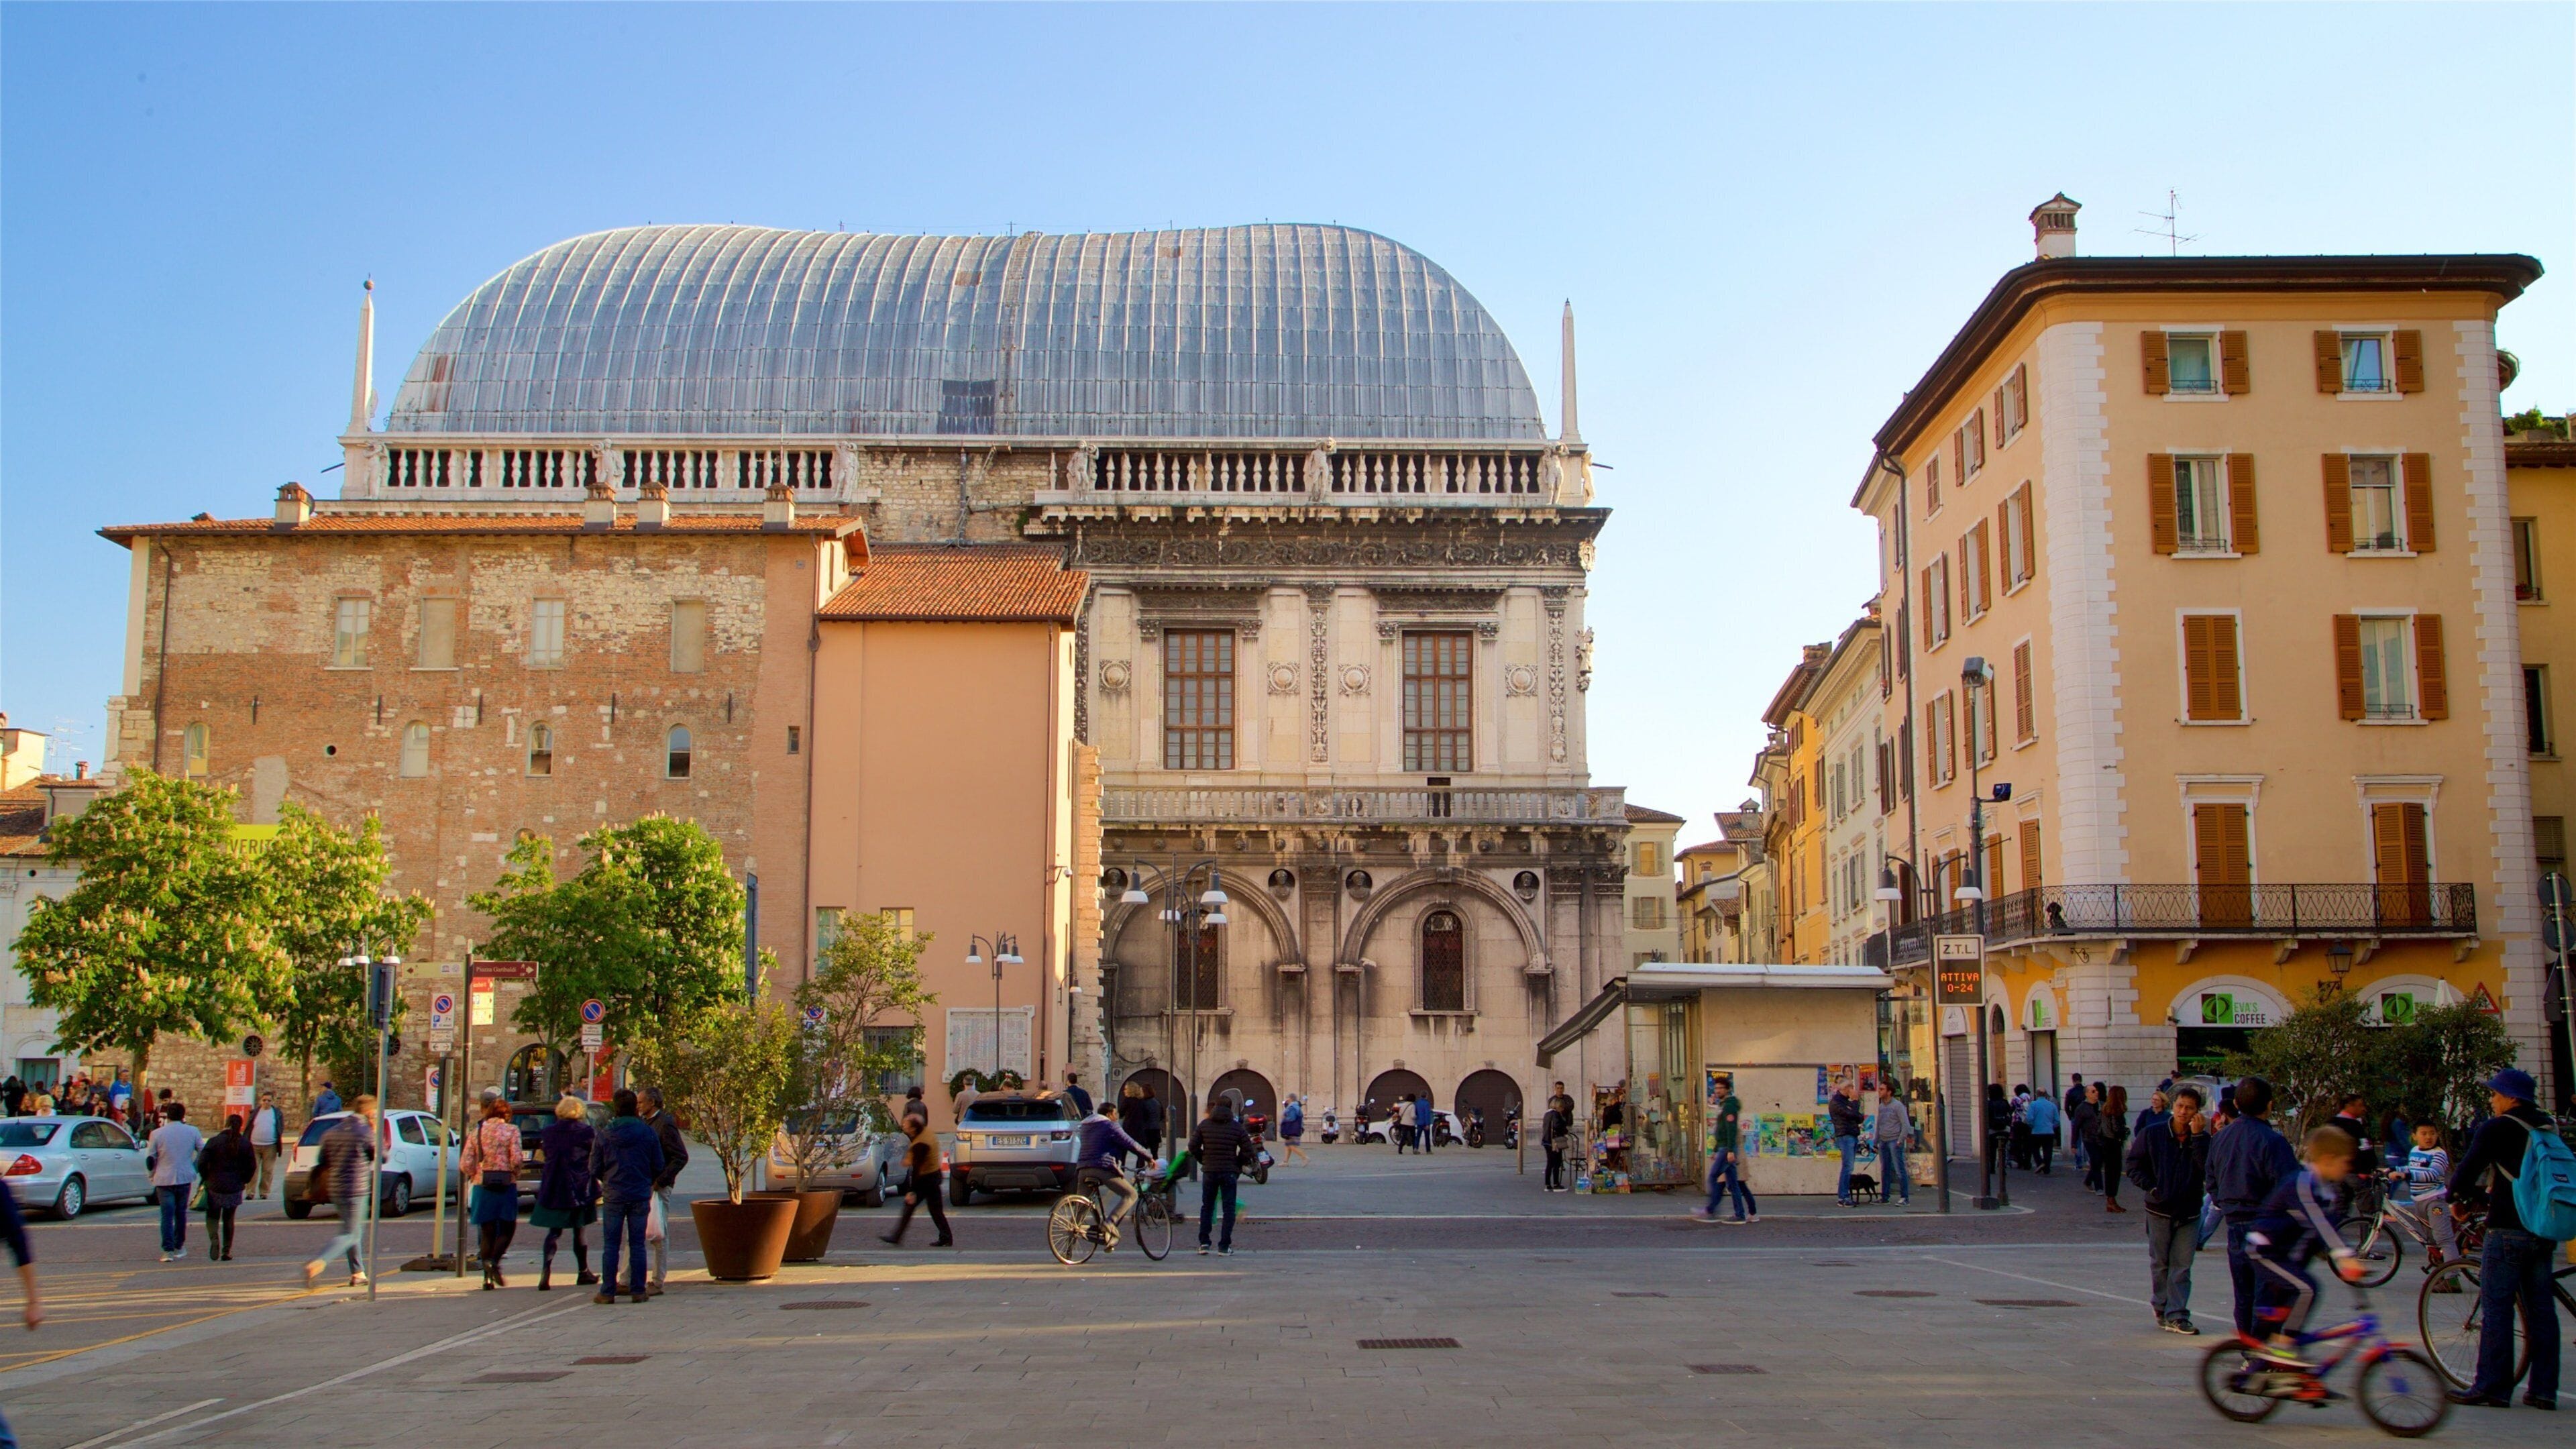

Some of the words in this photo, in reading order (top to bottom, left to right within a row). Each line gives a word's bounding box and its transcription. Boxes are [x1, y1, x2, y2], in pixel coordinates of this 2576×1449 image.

[230, 838, 276, 855] VERIT
[1943, 944, 1976, 954] Z.T.L.
[1940, 973, 1980, 982] ATTIVA
[1947, 983, 1973, 992] 0-24
[2234, 1002, 2258, 1013] EVA'S
[2235, 1014, 2266, 1024] COFFEE
